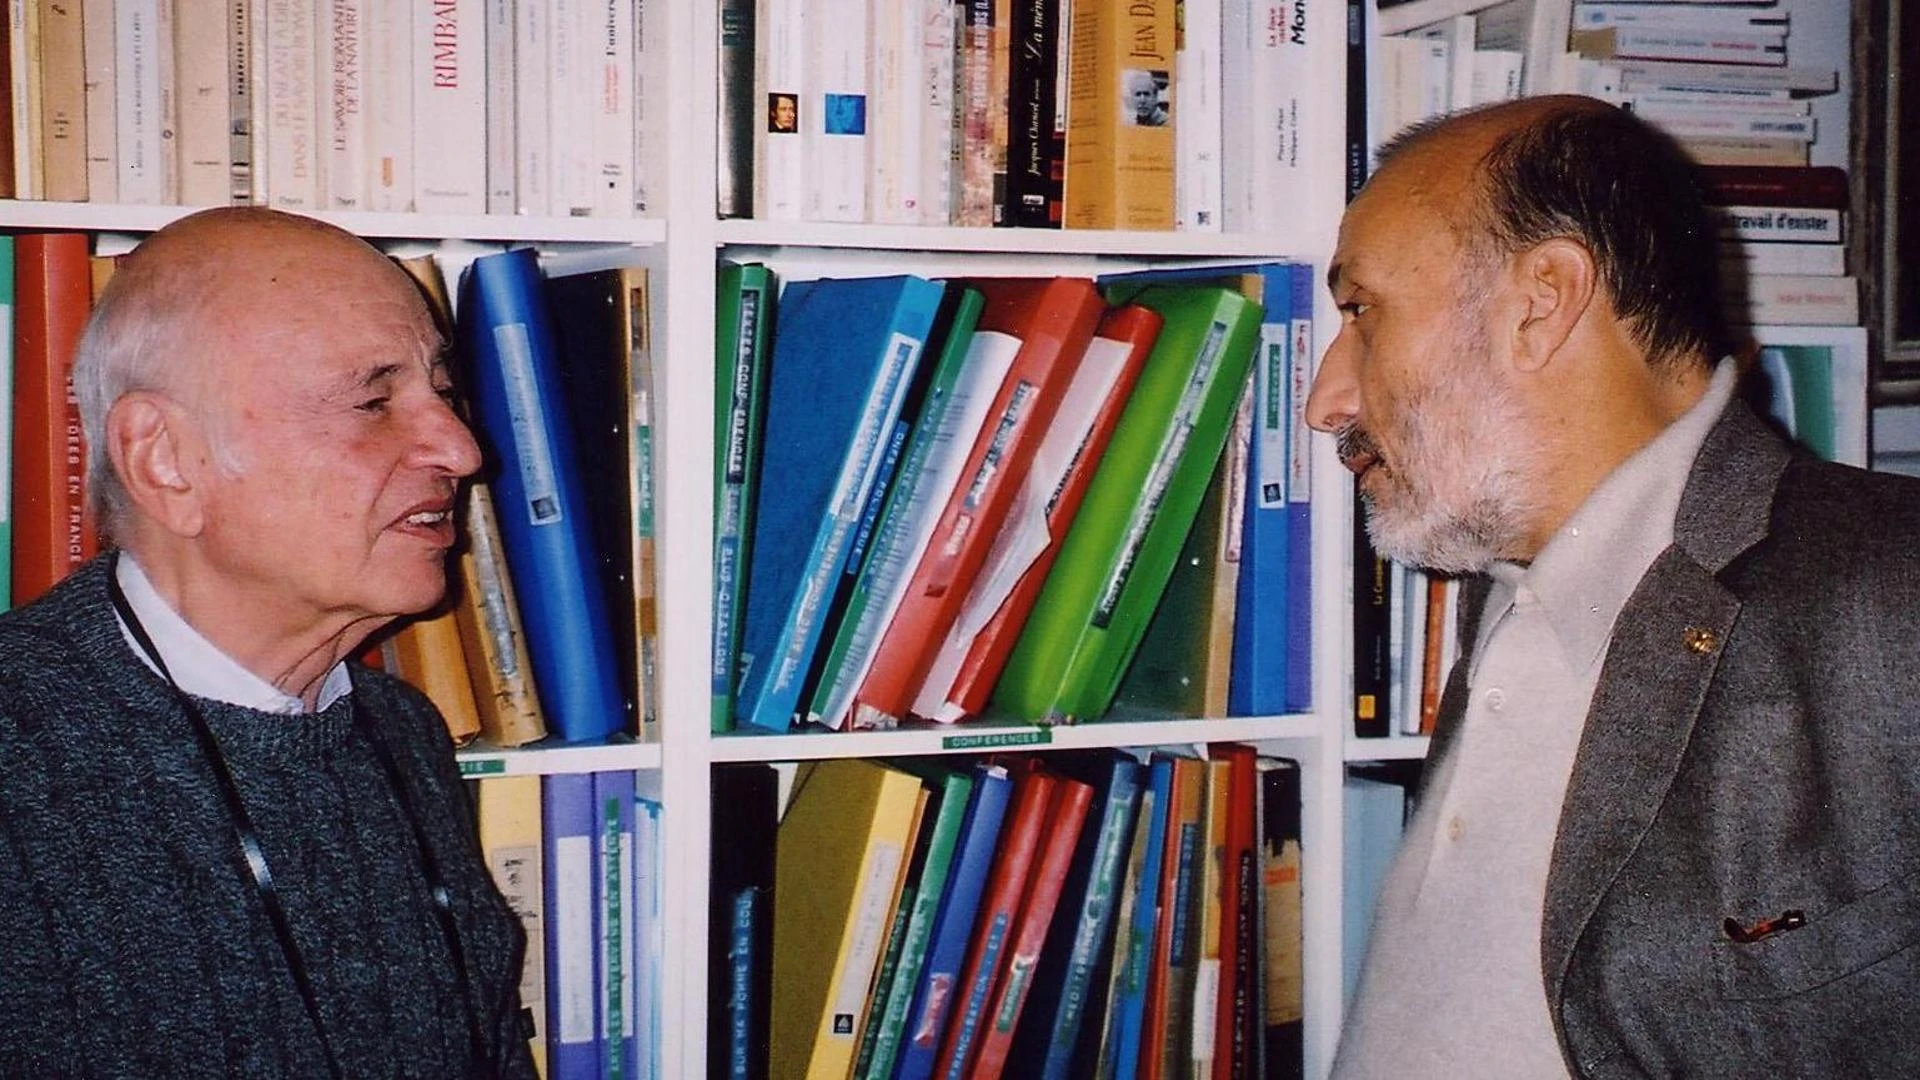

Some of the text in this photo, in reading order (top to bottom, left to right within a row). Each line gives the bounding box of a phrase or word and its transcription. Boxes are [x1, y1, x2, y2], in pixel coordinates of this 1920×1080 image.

[1130, 24, 1164, 61] JEAN
[334, 79, 346, 132] SAVOIR
[1028, 101, 1040, 139] Chancel
[1027, 141, 1041, 177] Jacques
[738, 300, 755, 358] TEXTES
[68, 475, 82, 495] EN
[68, 505, 82, 562] FRANCE
[951, 732, 1039, 747] CONFERENCES
[739, 935, 750, 955] EN
[735, 1046, 747, 1074] SUR
